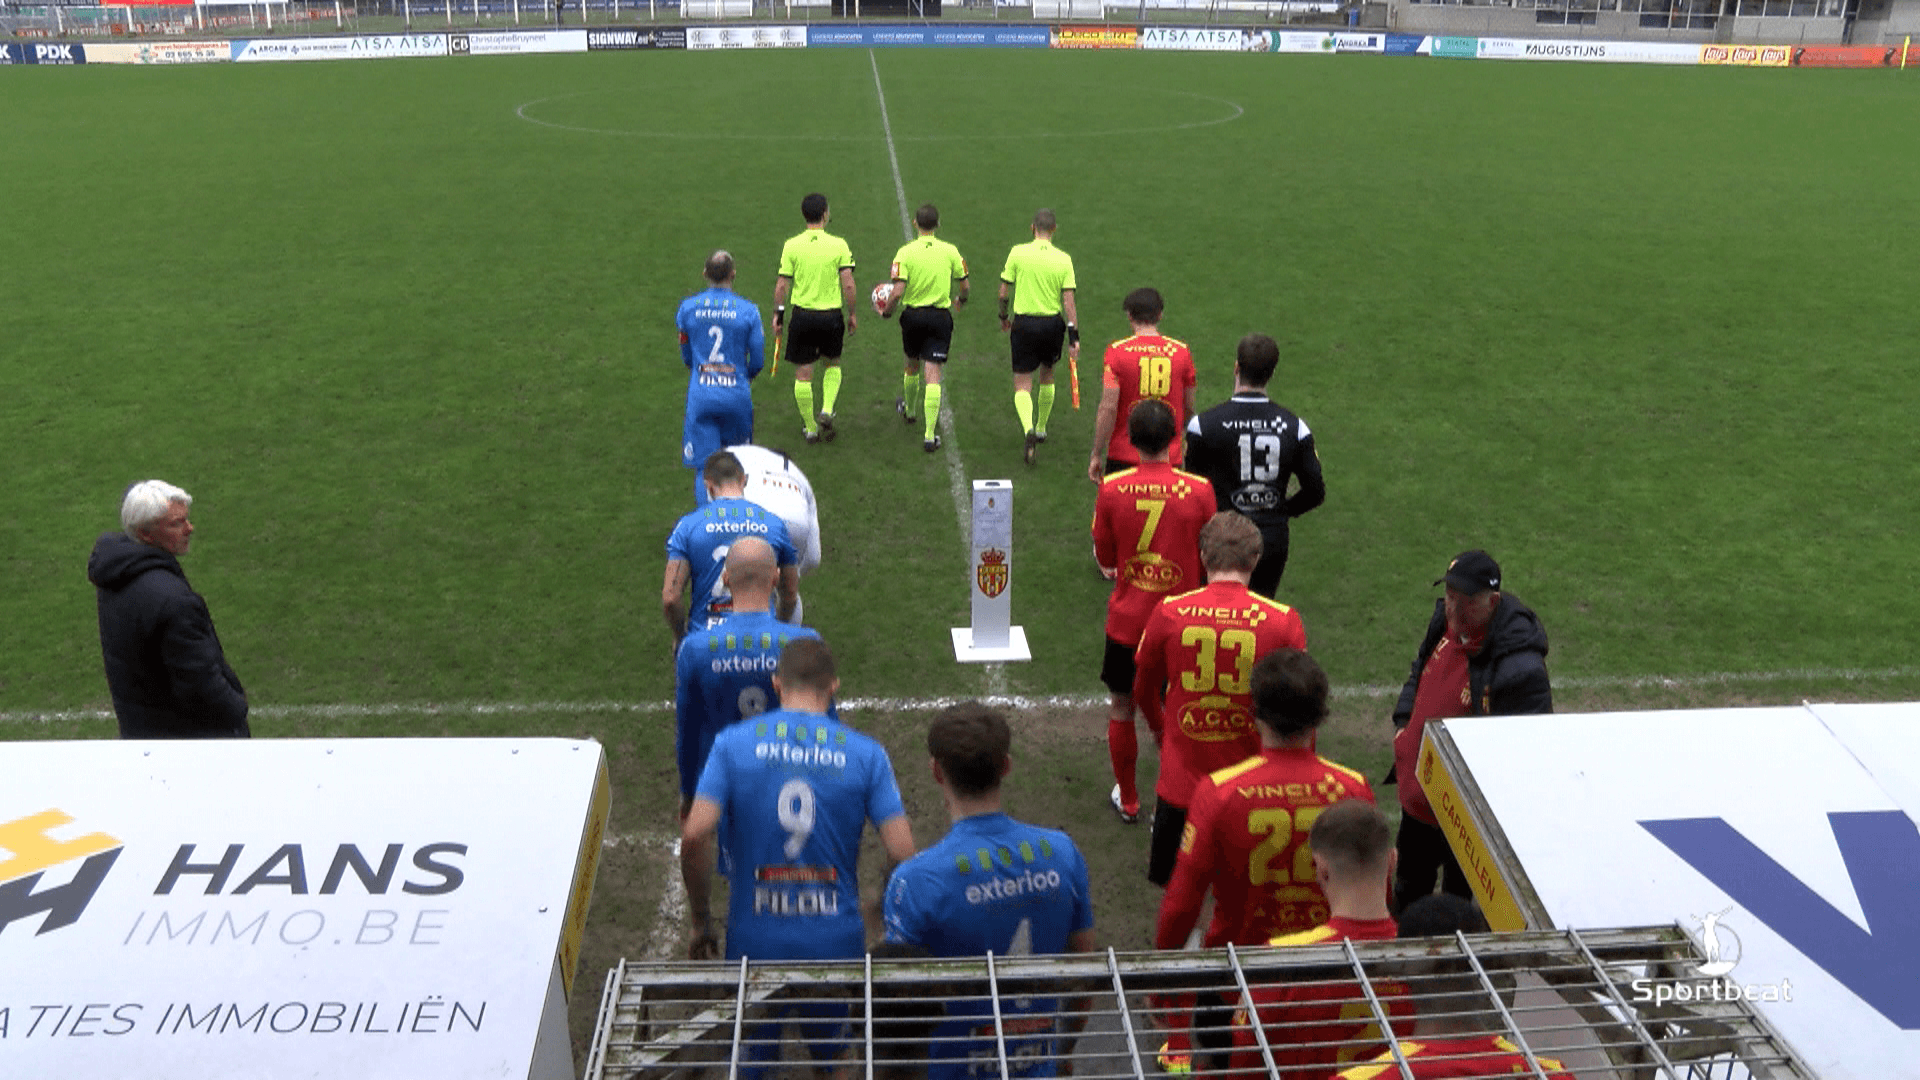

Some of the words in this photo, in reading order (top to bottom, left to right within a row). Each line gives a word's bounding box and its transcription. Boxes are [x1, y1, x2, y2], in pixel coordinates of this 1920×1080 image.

[259, 45, 288, 53] ARCADE
[351, 38, 394, 50] ATSA
[400, 35, 444, 49] ATSA
[452, 38, 469, 51] CB
[1146, 30, 1188, 41] ATSA
[1195, 31, 1238, 43] ATSA
[35, 44, 73, 59] PDK
[1526, 45, 1605, 57] AUGUSTIJNS
[708, 325, 725, 362] 2
[1139, 356, 1171, 397] 18
[1222, 420, 1267, 429] VINCI
[1238, 434, 1280, 481] 13
[1118, 484, 1167, 493] VINCI
[706, 519, 768, 534] exterioo
[1136, 499, 1166, 551] 7
[1177, 606, 1237, 618] VINCI
[711, 652, 777, 673] exterio
[1181, 625, 1256, 695] 33
[755, 742, 847, 769] exterioo
[1237, 783, 1312, 798] VINCI
[778, 777, 816, 860] 9
[1442, 791, 1495, 901] CAPPELLEN
[153, 842, 469, 896] HANS
[965, 868, 1061, 904] exterioo
[755, 887, 838, 916] FILOU
[123, 908, 450, 947] IMMO.BE
[156, 994, 487, 1035] IMMOBILIËN
